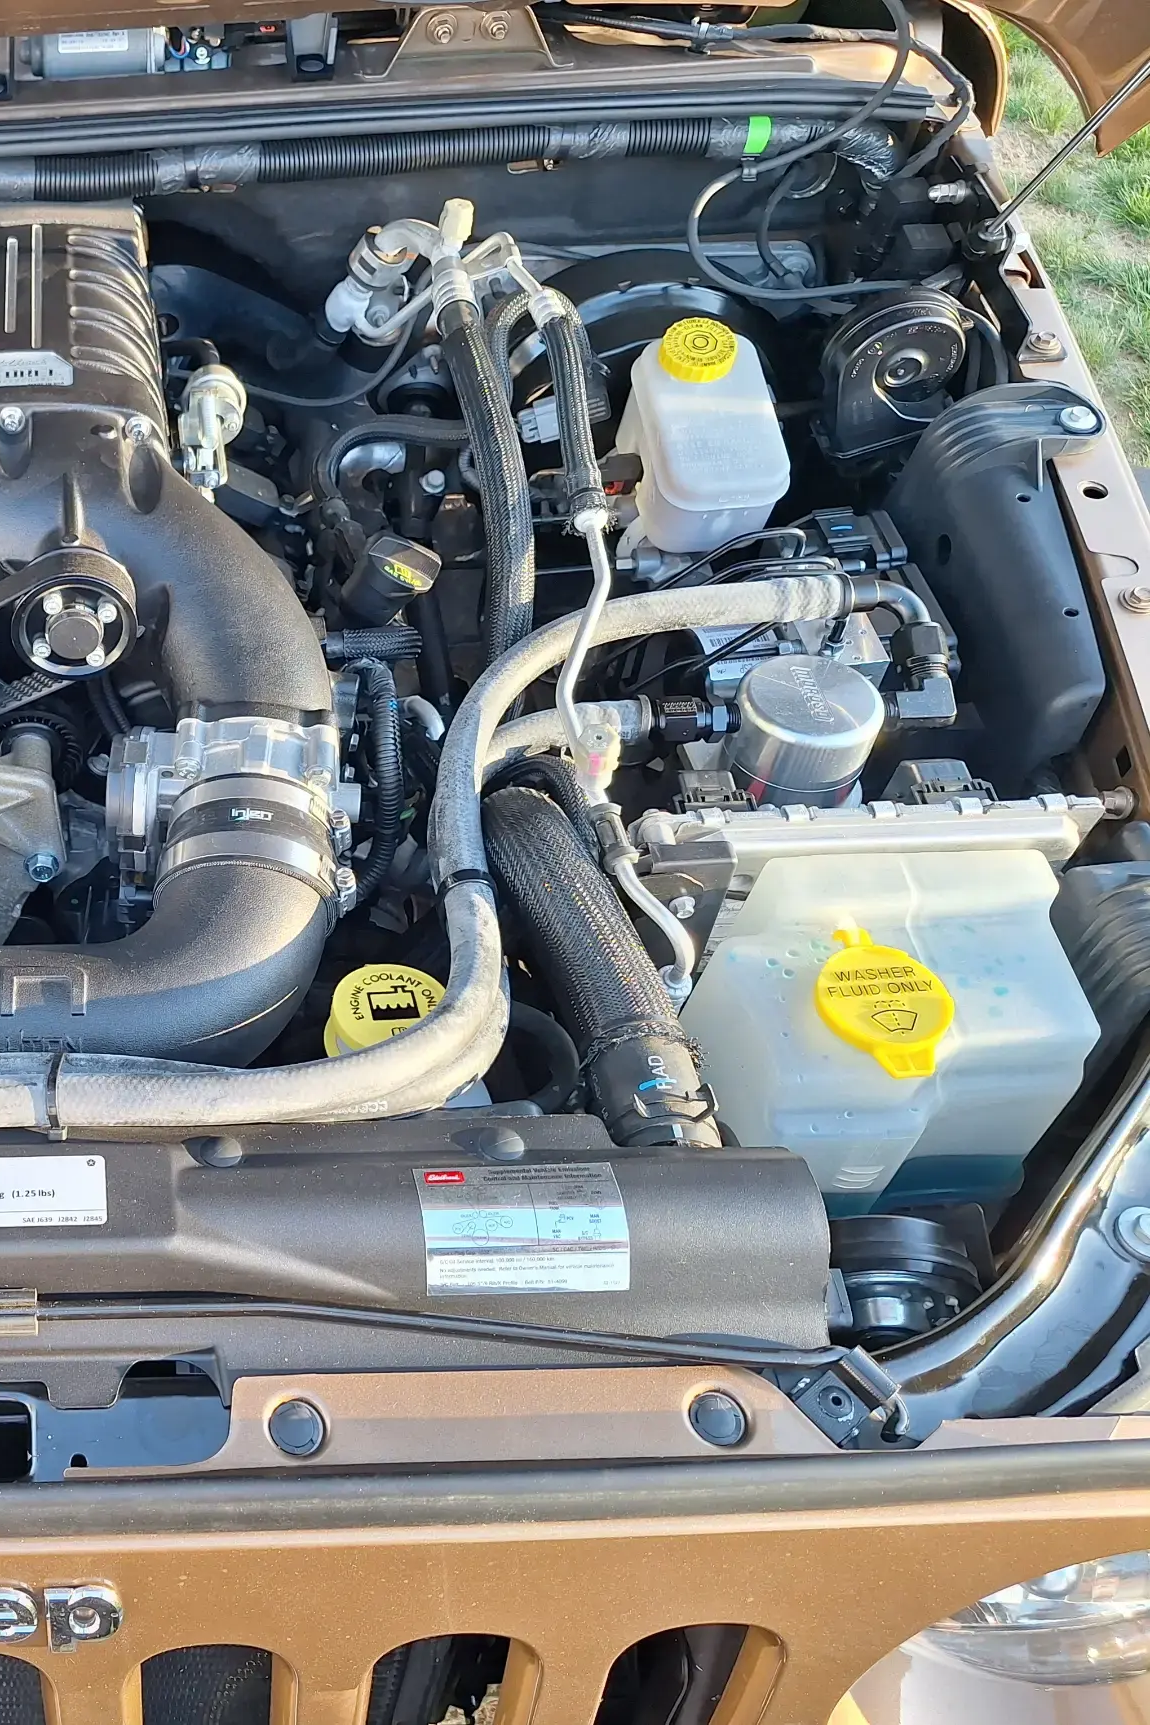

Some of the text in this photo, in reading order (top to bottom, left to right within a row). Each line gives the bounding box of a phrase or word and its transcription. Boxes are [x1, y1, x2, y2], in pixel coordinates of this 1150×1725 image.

[834, 965, 917, 982] WASHER
[349, 972, 438, 1021] ENGINE COOLANT ONL
[826, 980, 934, 998] FLUID ONLY
[488, 1168, 532, 1176] Supplemental
[11, 1189, 37, 1199] (1.25
[38, 1188, 56, 1198] lbs)
